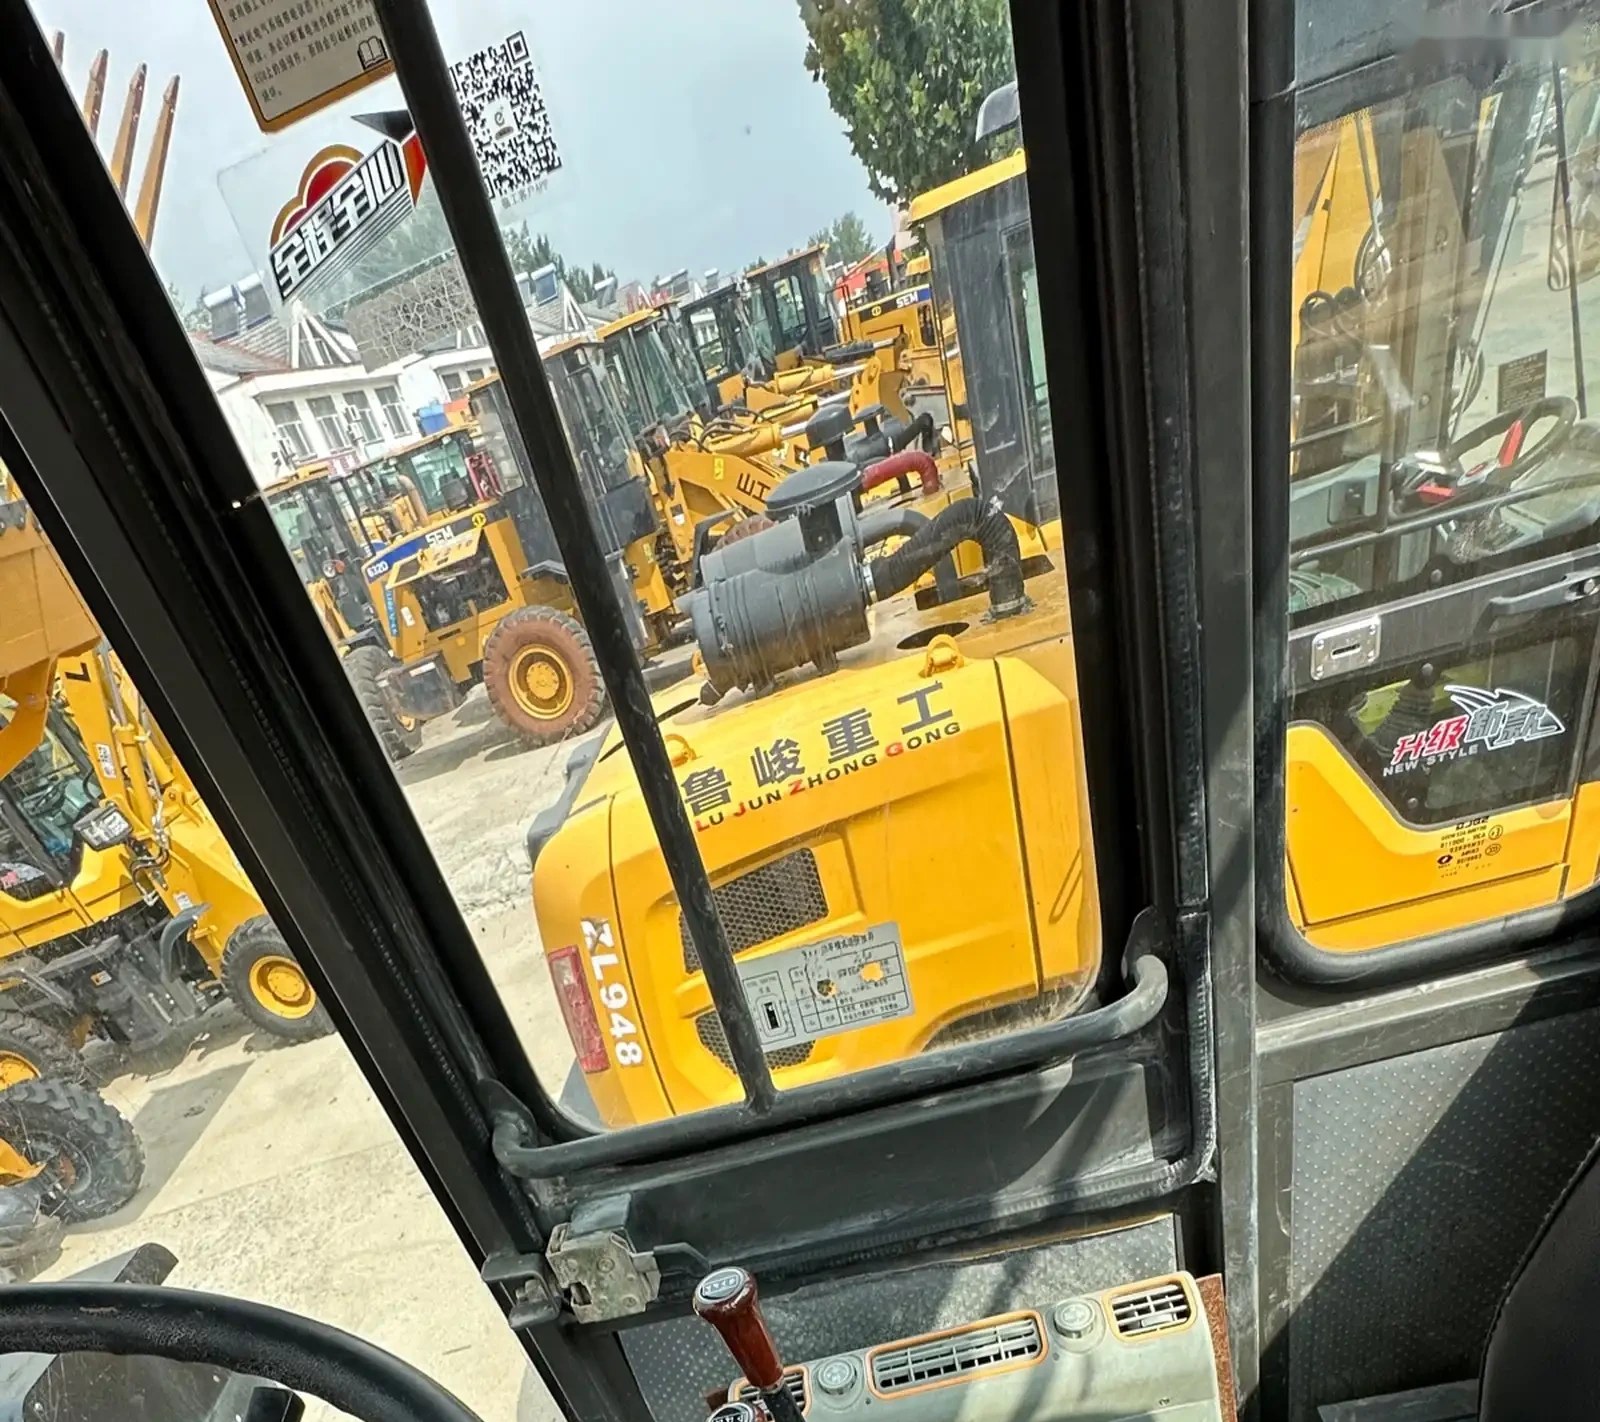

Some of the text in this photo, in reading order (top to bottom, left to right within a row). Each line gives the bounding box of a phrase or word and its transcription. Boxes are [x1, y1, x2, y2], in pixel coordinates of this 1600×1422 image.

[272, 140, 404, 298] 全程全心
[895, 291, 918, 309] SEM
[425, 525, 454, 548] SEM
[680, 680, 954, 816] 鲁峻重工
[1383, 743, 1479, 777] NEW STYLE
[1390, 700, 1558, 766] 升级新款
[694, 721, 961, 832] LU JUN ZHONG GONG
